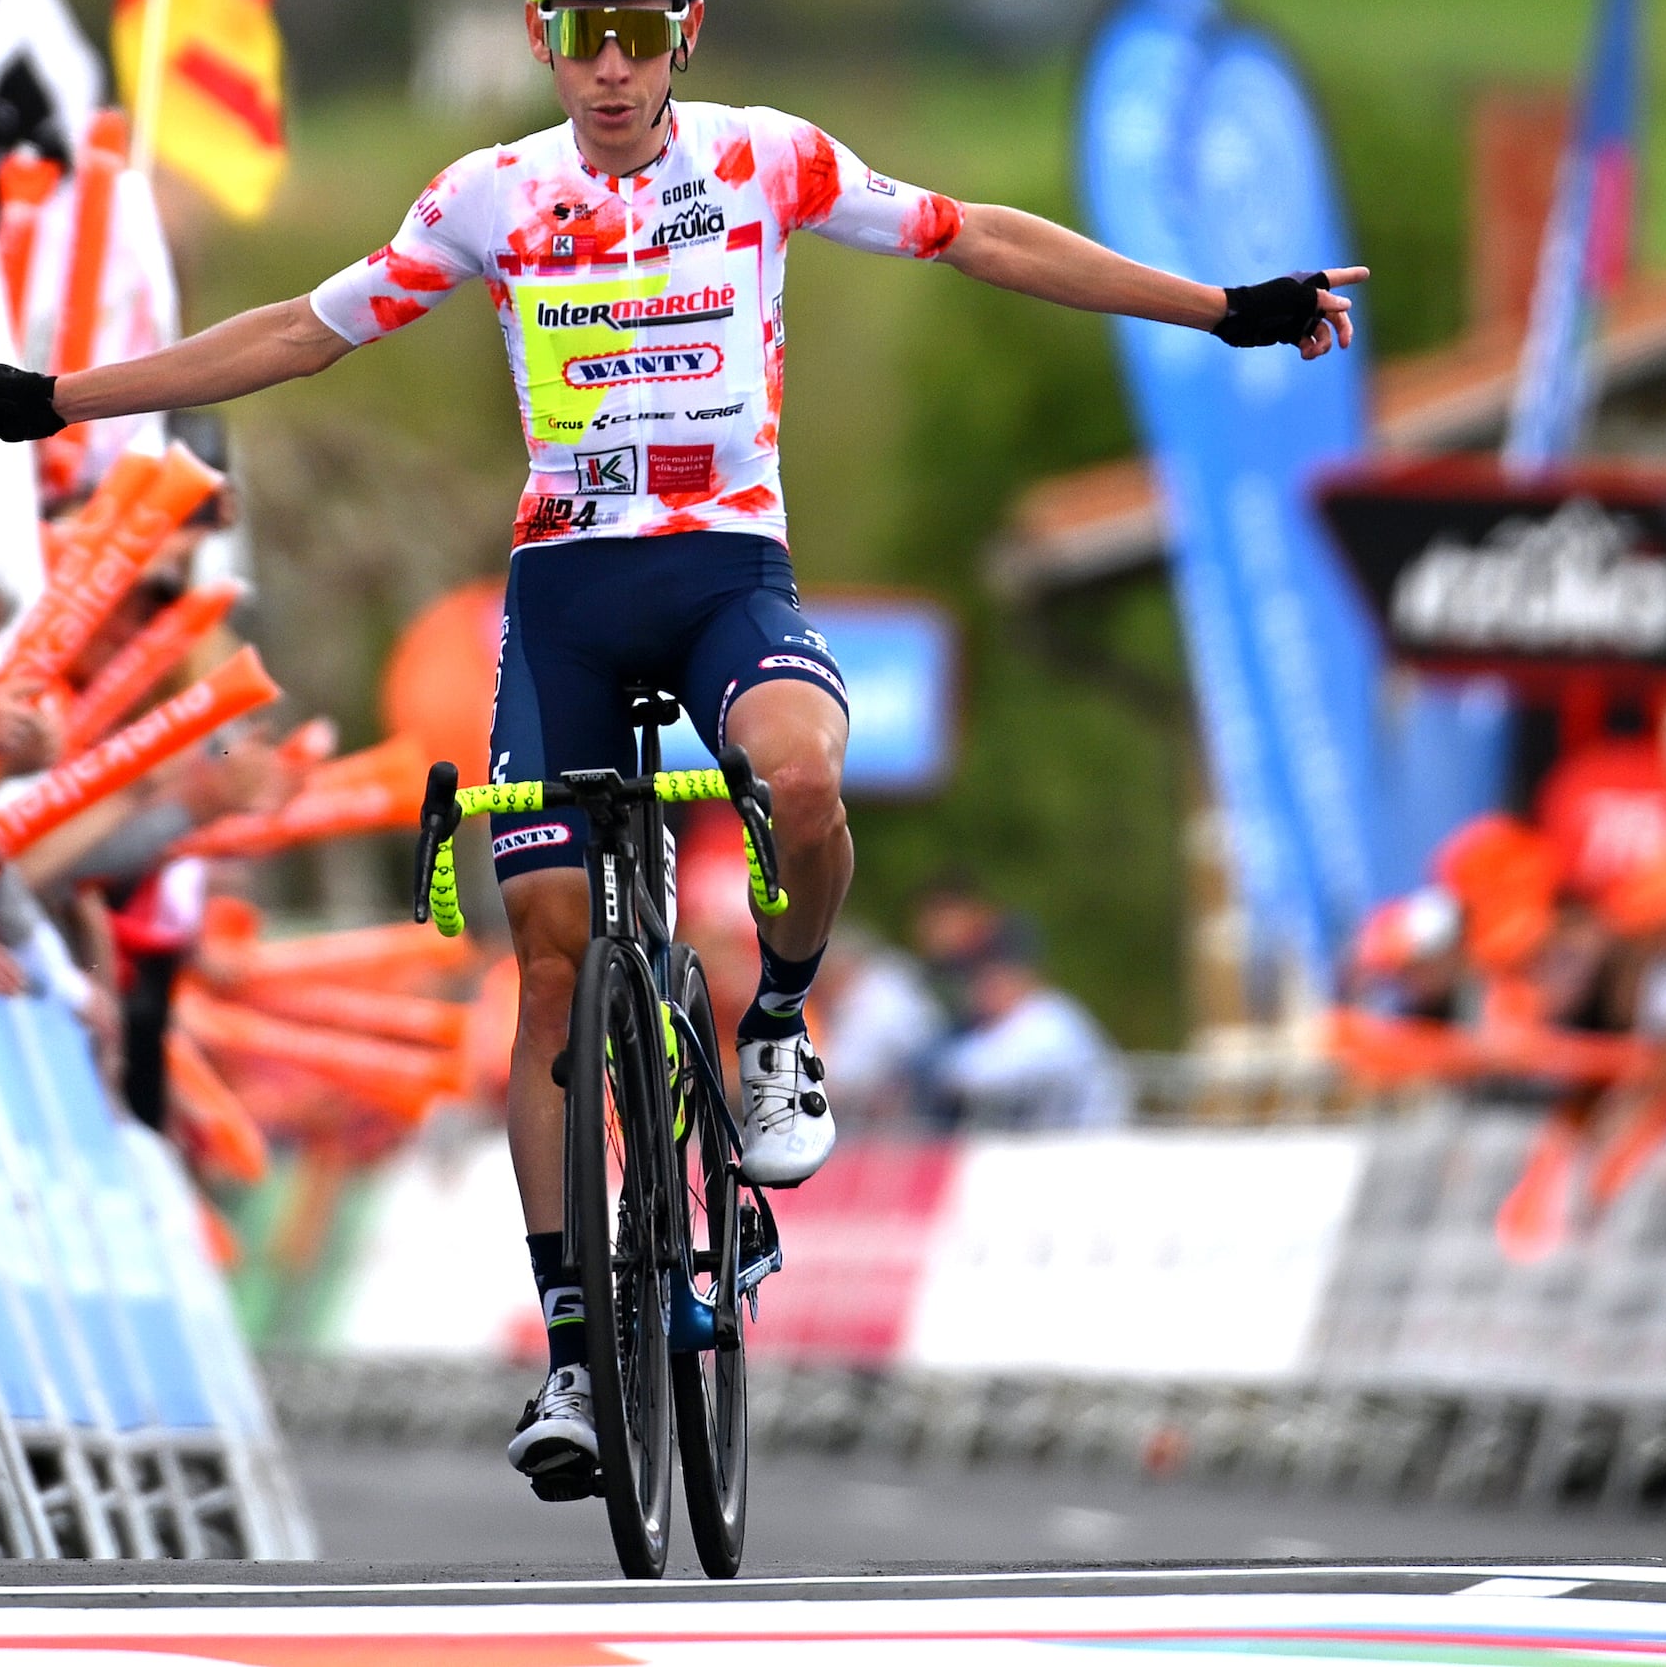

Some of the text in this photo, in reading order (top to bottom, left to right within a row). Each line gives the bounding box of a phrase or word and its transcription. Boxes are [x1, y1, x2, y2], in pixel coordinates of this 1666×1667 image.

[662, 179, 707, 206] GOBIK
[579, 352, 704, 381] WANTY
[685, 403, 744, 421] VERGE
[603, 853, 618, 922] CUBE
